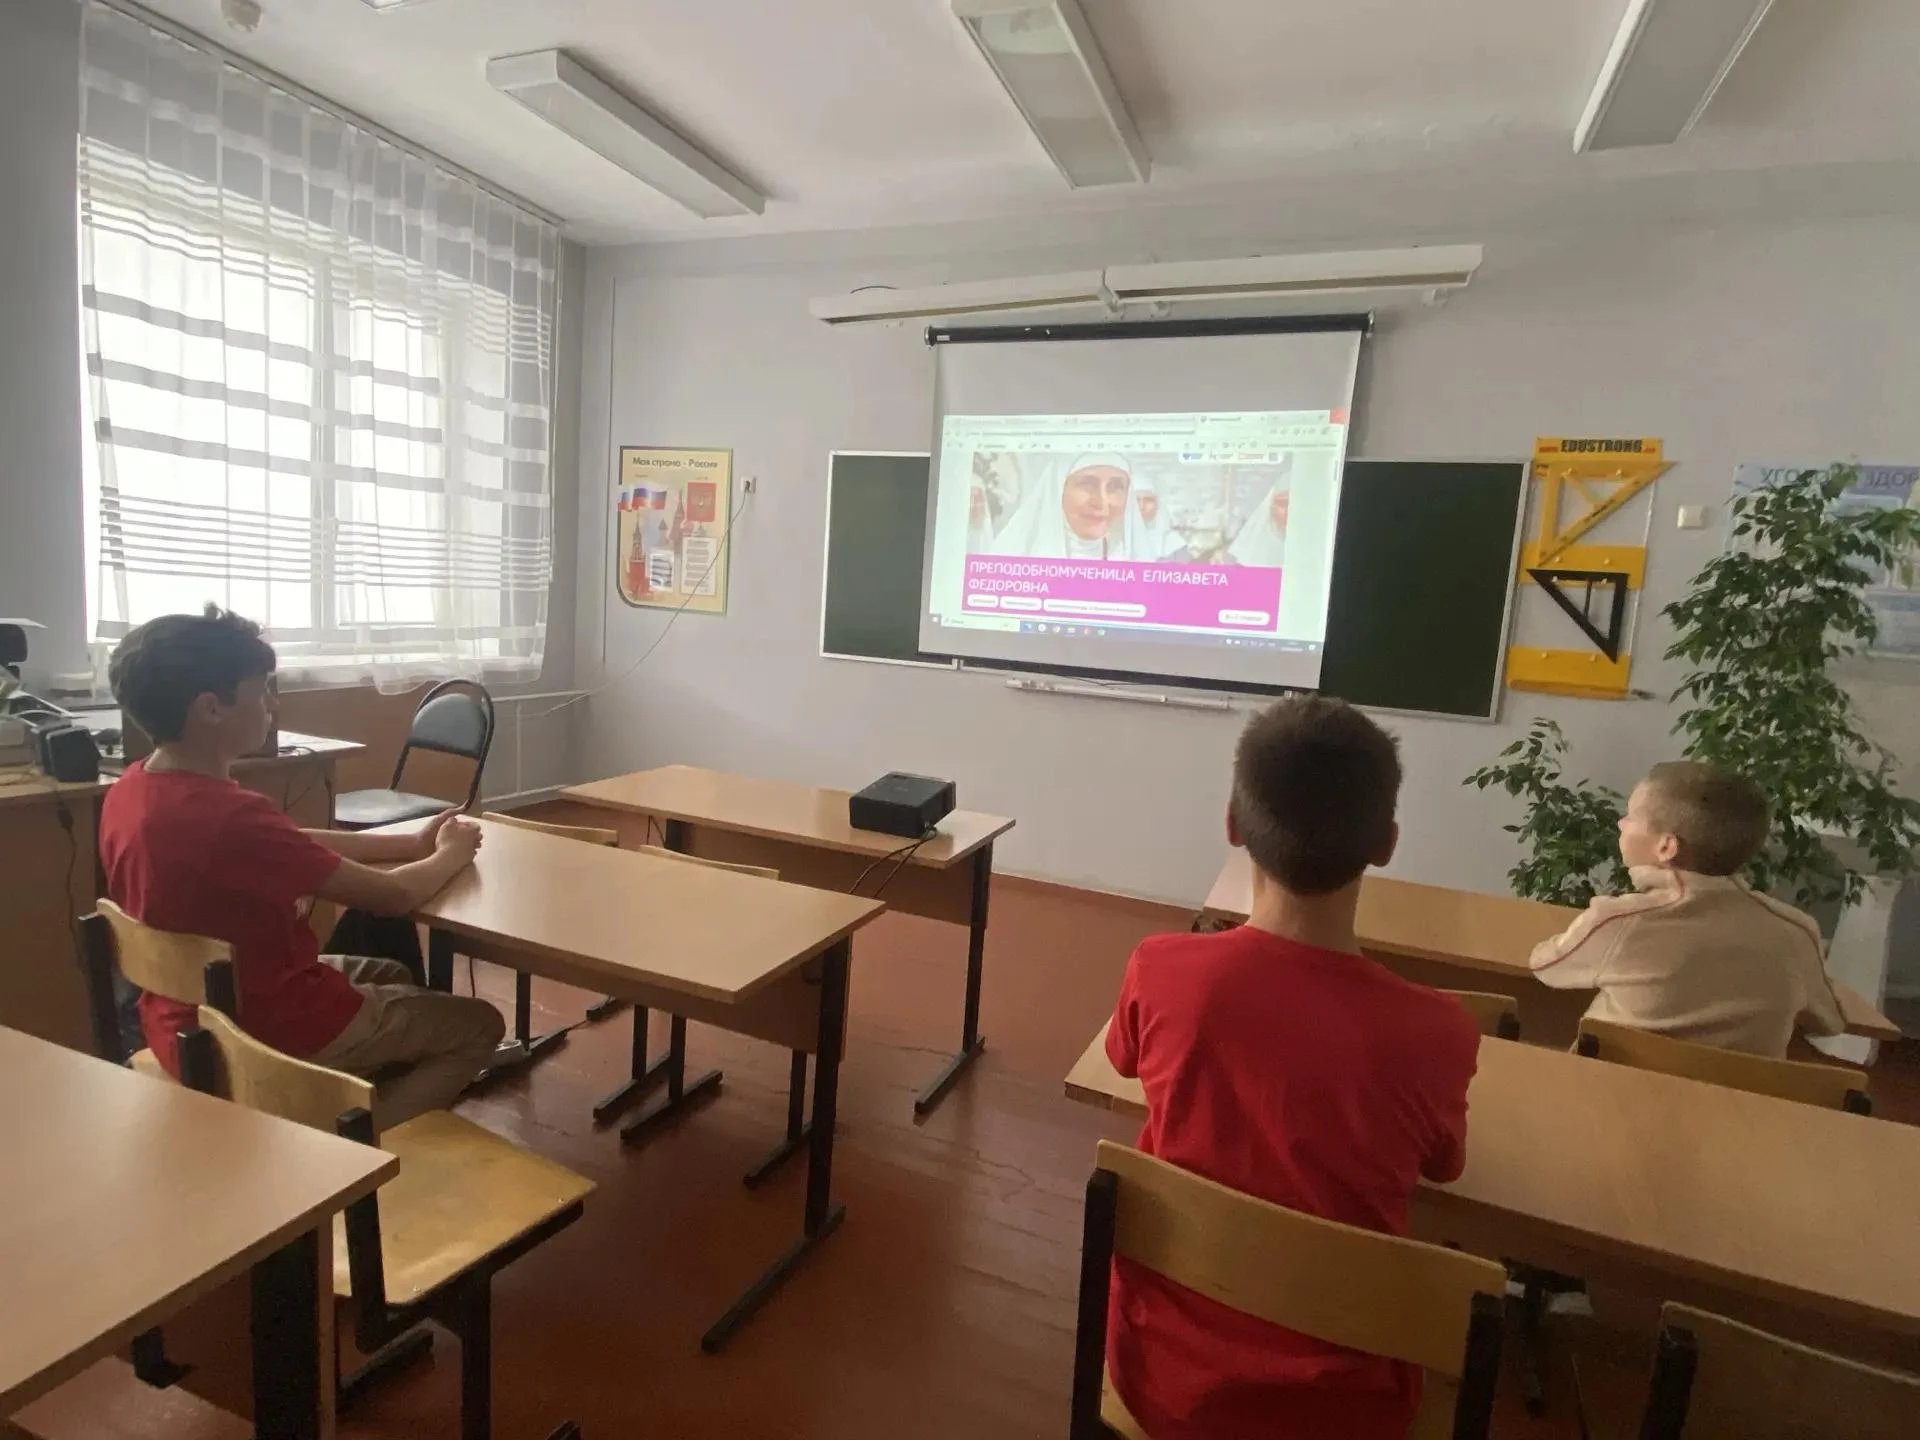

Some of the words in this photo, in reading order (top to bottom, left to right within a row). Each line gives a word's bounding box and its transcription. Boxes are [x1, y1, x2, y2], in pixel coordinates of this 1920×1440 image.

[632, 457, 650, 466] Моя
[652, 459, 681, 468] страна
[688, 458, 718, 468] Россия
[969, 561, 1136, 583] ПРЕПОДОБНОМУЧЕНИЦА
[1142, 569, 1229, 586] ЕЛИЗАВЕТА
[968, 578, 1049, 594] ФЕДОРОВНА
